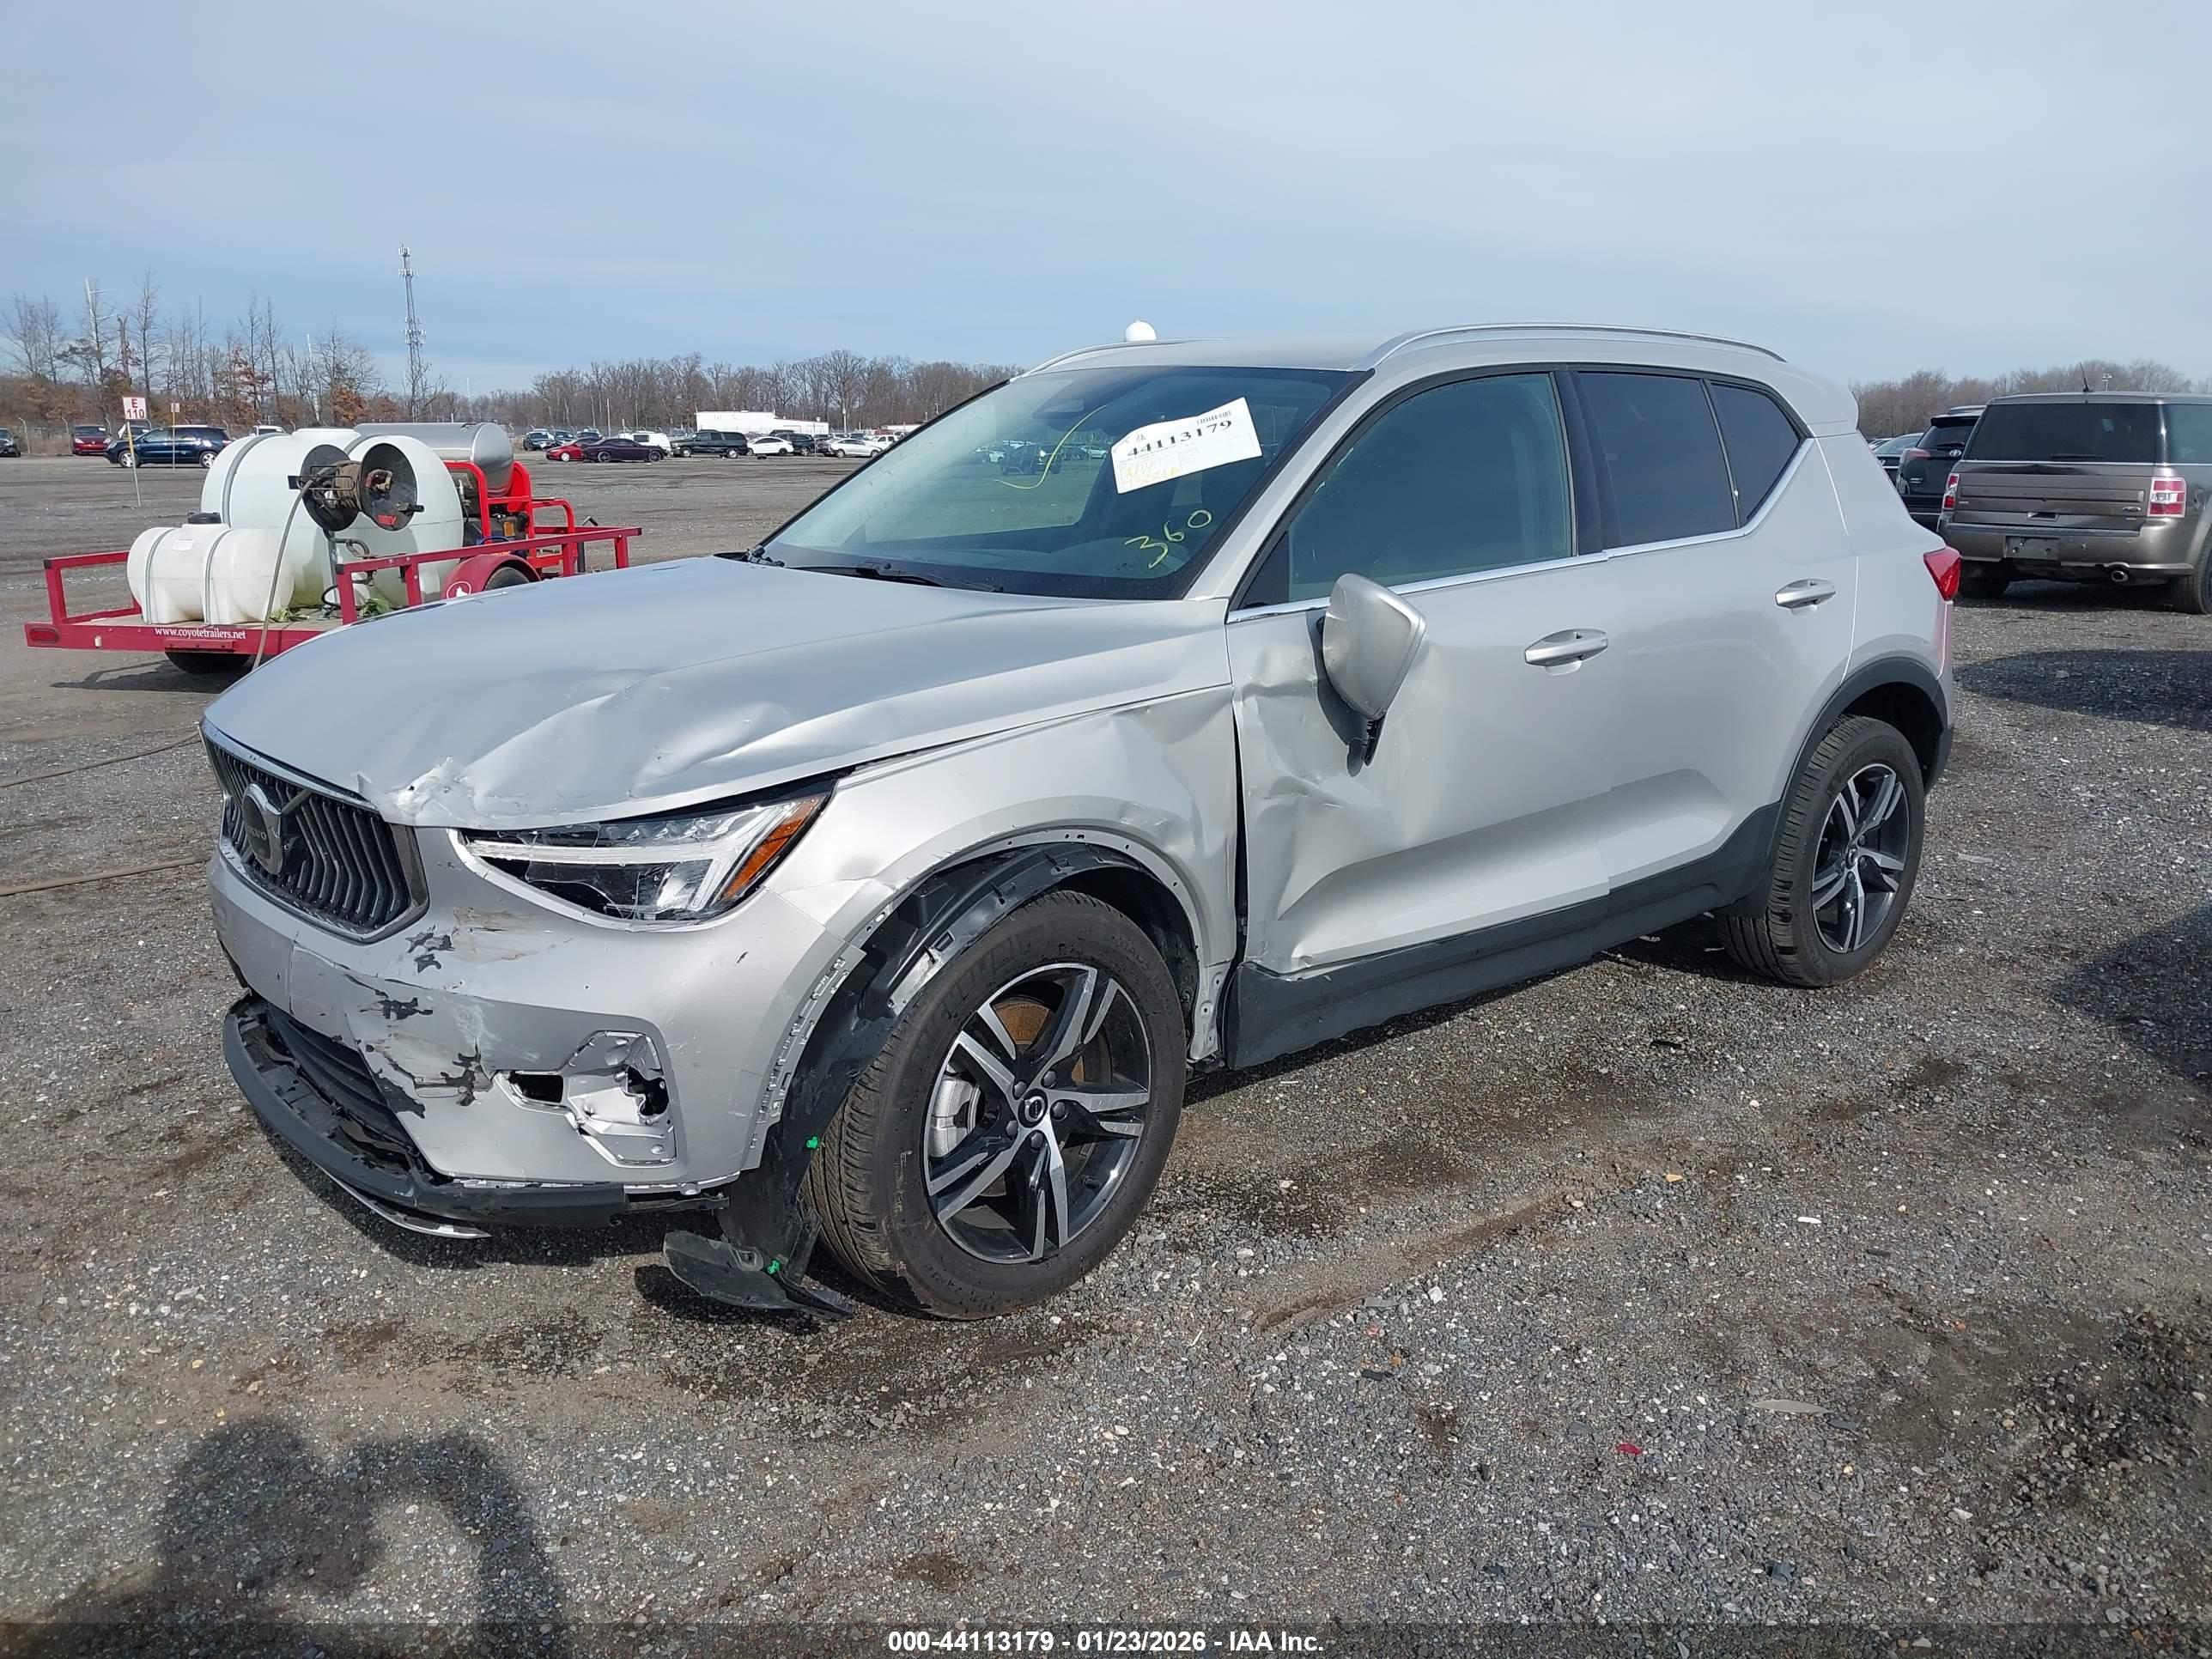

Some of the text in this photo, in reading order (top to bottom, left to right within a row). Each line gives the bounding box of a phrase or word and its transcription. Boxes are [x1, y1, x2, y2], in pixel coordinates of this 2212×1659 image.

[131, 398, 138, 409] E
[126, 409, 145, 419] 110
[1127, 419, 1233, 458] 44113179
[1124, 509, 1212, 569] 360
[155, 627, 246, 640] www.coyotetrailers.net
